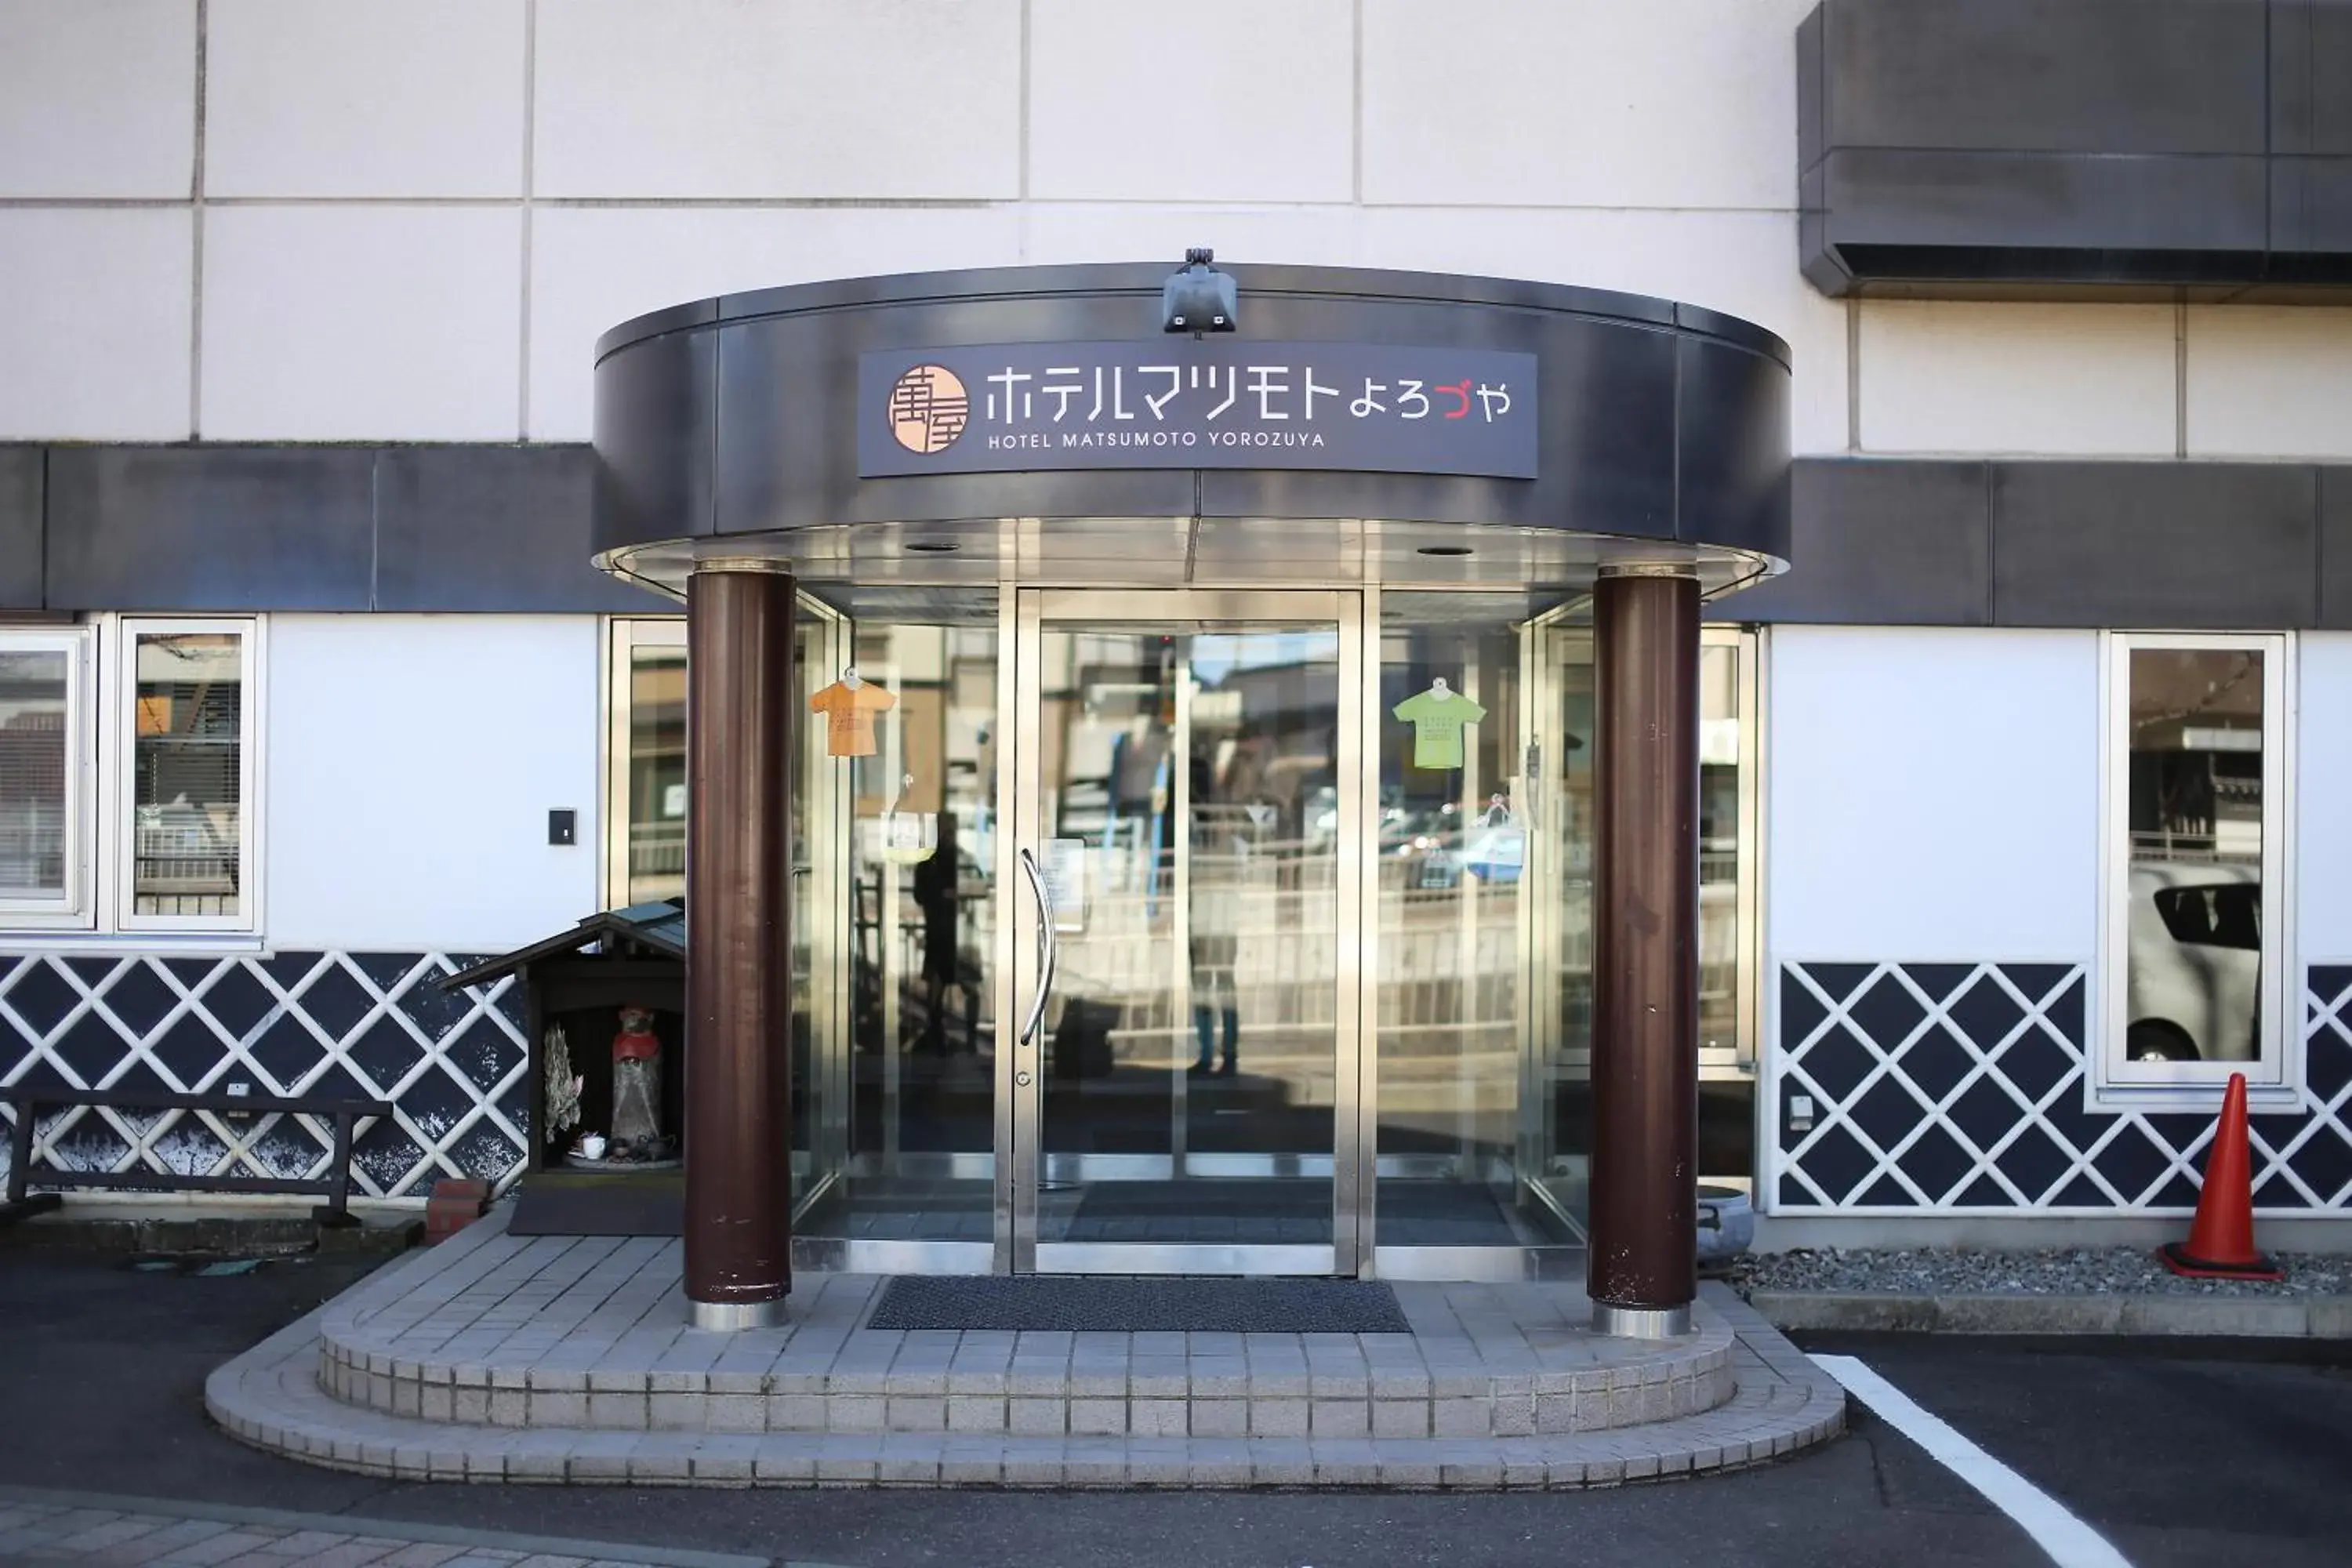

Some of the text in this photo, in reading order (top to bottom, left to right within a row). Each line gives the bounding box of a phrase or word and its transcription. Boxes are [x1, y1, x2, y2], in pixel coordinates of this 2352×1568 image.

[988, 432, 1324, 449] HOTEL MATSUMOTO YOROZUYA
